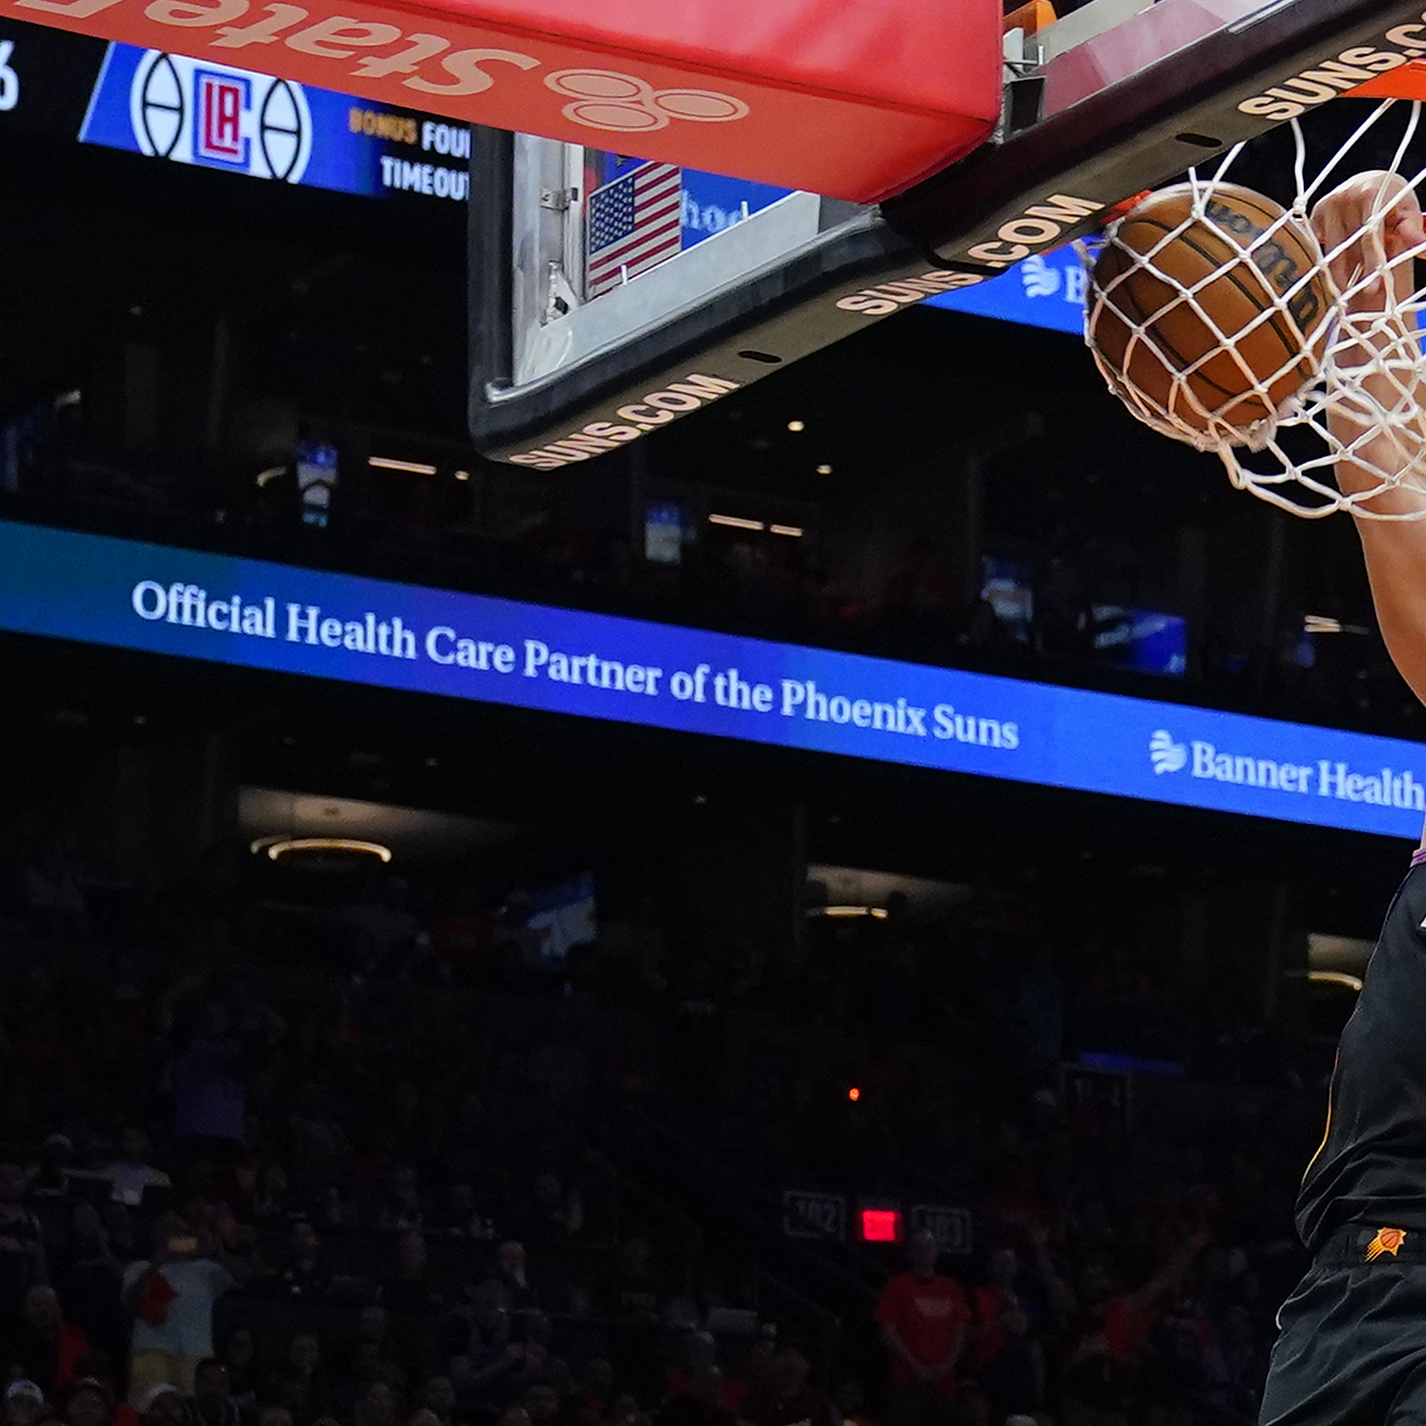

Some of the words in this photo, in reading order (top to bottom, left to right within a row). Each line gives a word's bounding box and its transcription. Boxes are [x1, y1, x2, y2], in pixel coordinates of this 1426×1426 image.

[349, 107, 418, 145] BONUS
[835, 193, 1106, 317] SUNS.COM
[508, 372, 741, 470] SUNS.COM
[132, 580, 275, 639] Official
[286, 605, 416, 660] Health
[425, 626, 515, 673] Care
[524, 640, 661, 696] Partner
[670, 664, 710, 703] of
[714, 669, 773, 713] the
[781, 680, 926, 736] Phoenix
[934, 705, 1019, 749] Suns
[1192, 742, 1313, 793] Banner
[1318, 760, 1425, 810] Health
